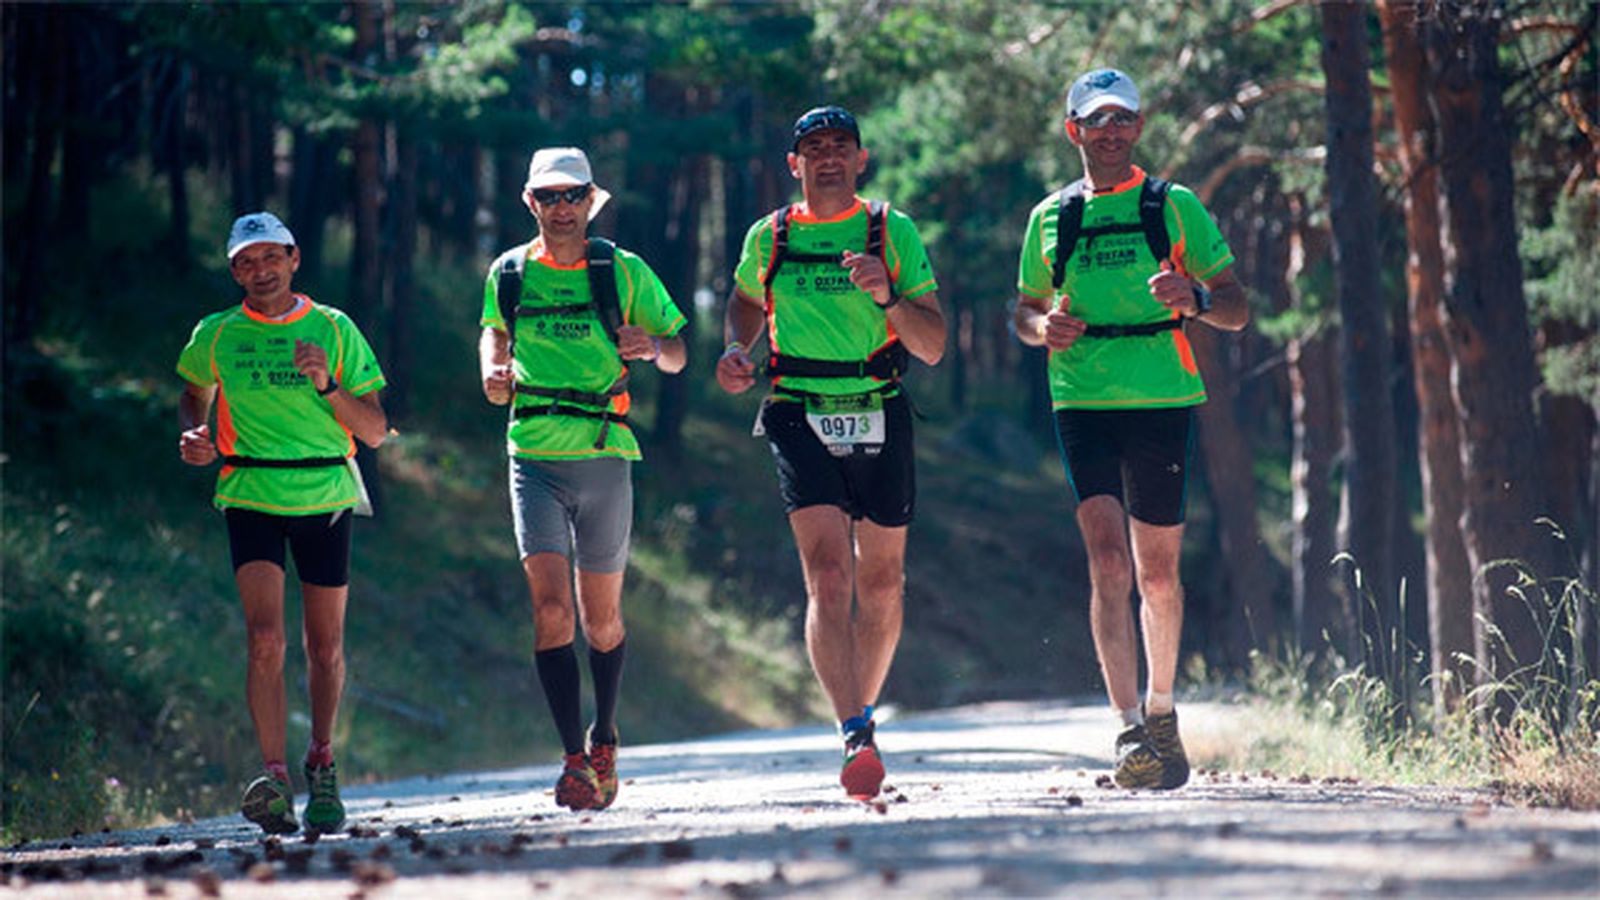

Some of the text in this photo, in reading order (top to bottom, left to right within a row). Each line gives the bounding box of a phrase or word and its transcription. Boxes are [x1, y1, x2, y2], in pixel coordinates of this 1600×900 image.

[1096, 249, 1136, 260] OXFAM
[552, 322, 591, 331] OXFAM
[820, 414, 871, 437] 0973
